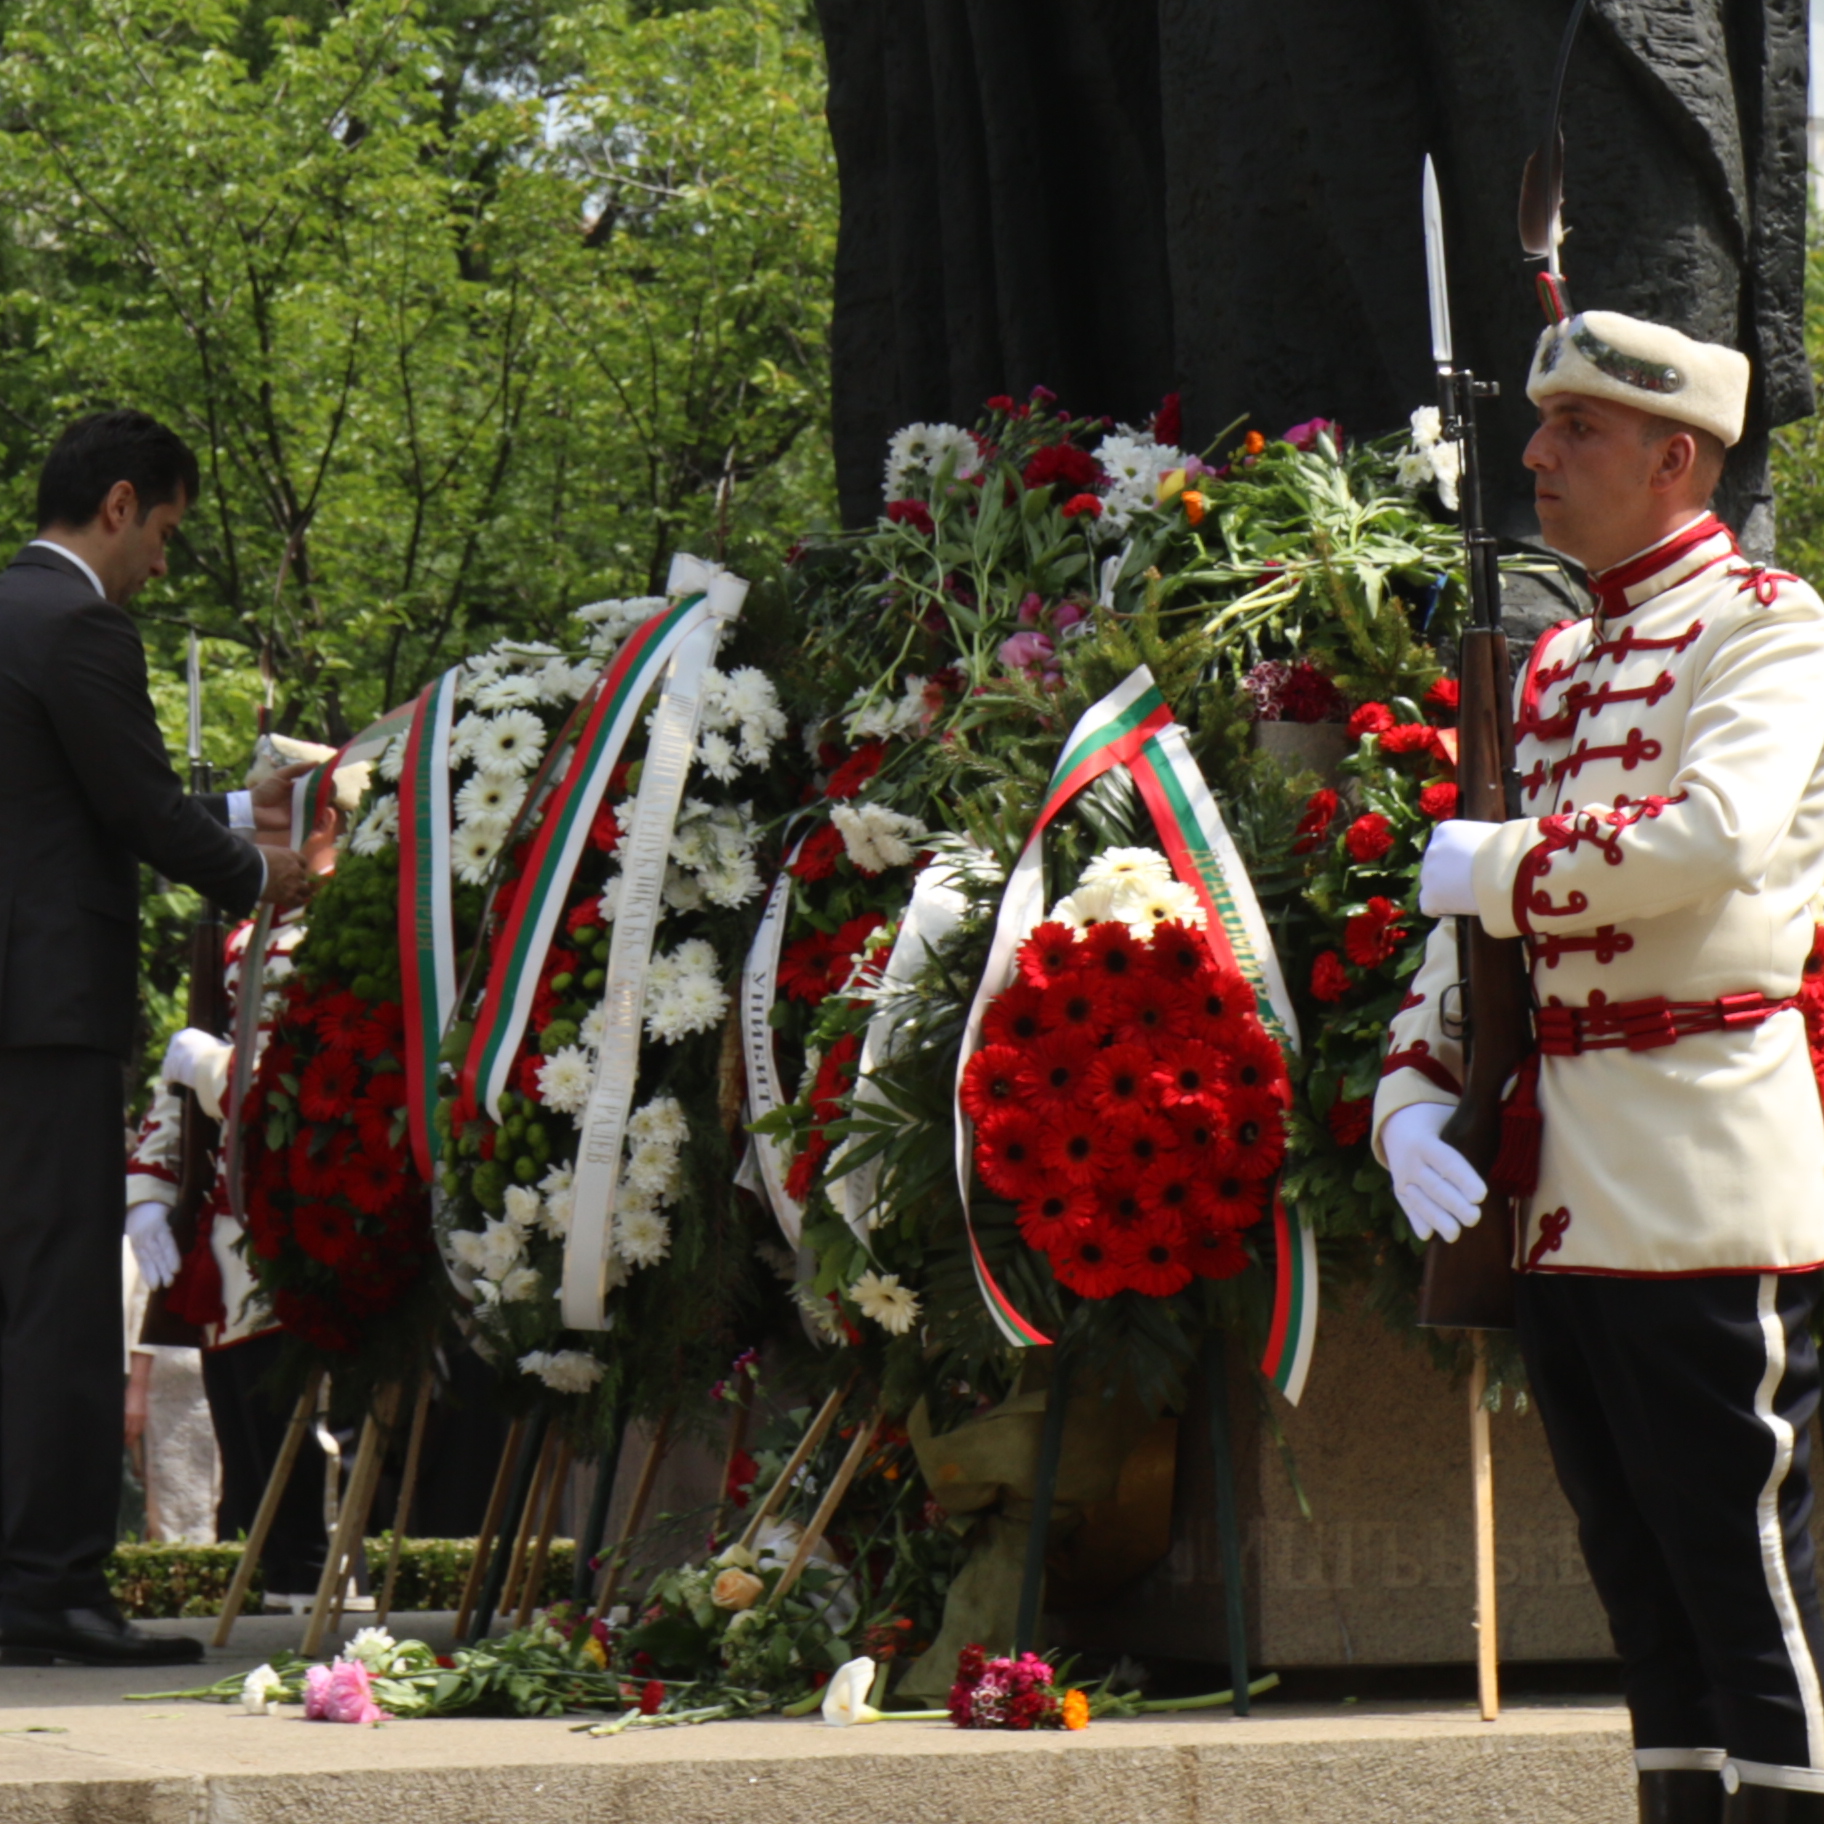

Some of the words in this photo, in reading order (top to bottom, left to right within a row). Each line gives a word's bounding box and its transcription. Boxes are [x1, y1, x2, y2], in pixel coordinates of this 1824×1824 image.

[1181, 849, 1271, 1001] ДРАГОМИР
[1256, 1013, 1295, 1052] ЗА
[751, 972, 772, 1108] УНИБИТ
[589, 1106, 619, 1166] РАДЕВ
